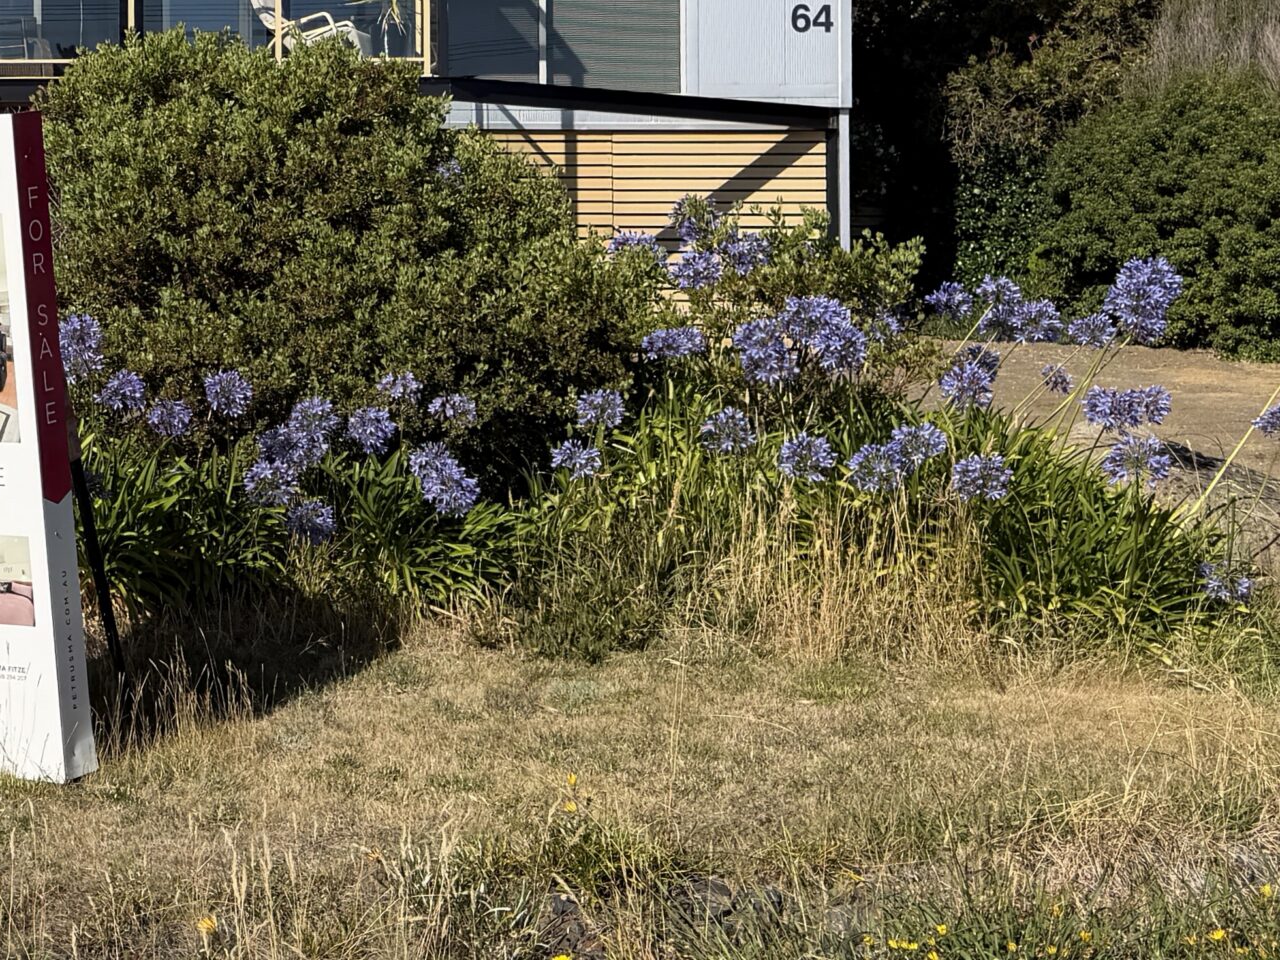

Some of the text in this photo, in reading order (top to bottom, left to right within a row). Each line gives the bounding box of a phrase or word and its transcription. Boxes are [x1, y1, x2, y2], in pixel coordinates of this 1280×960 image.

[791, 3, 834, 33] 64
[26, 185, 59, 425] FOR SALE
